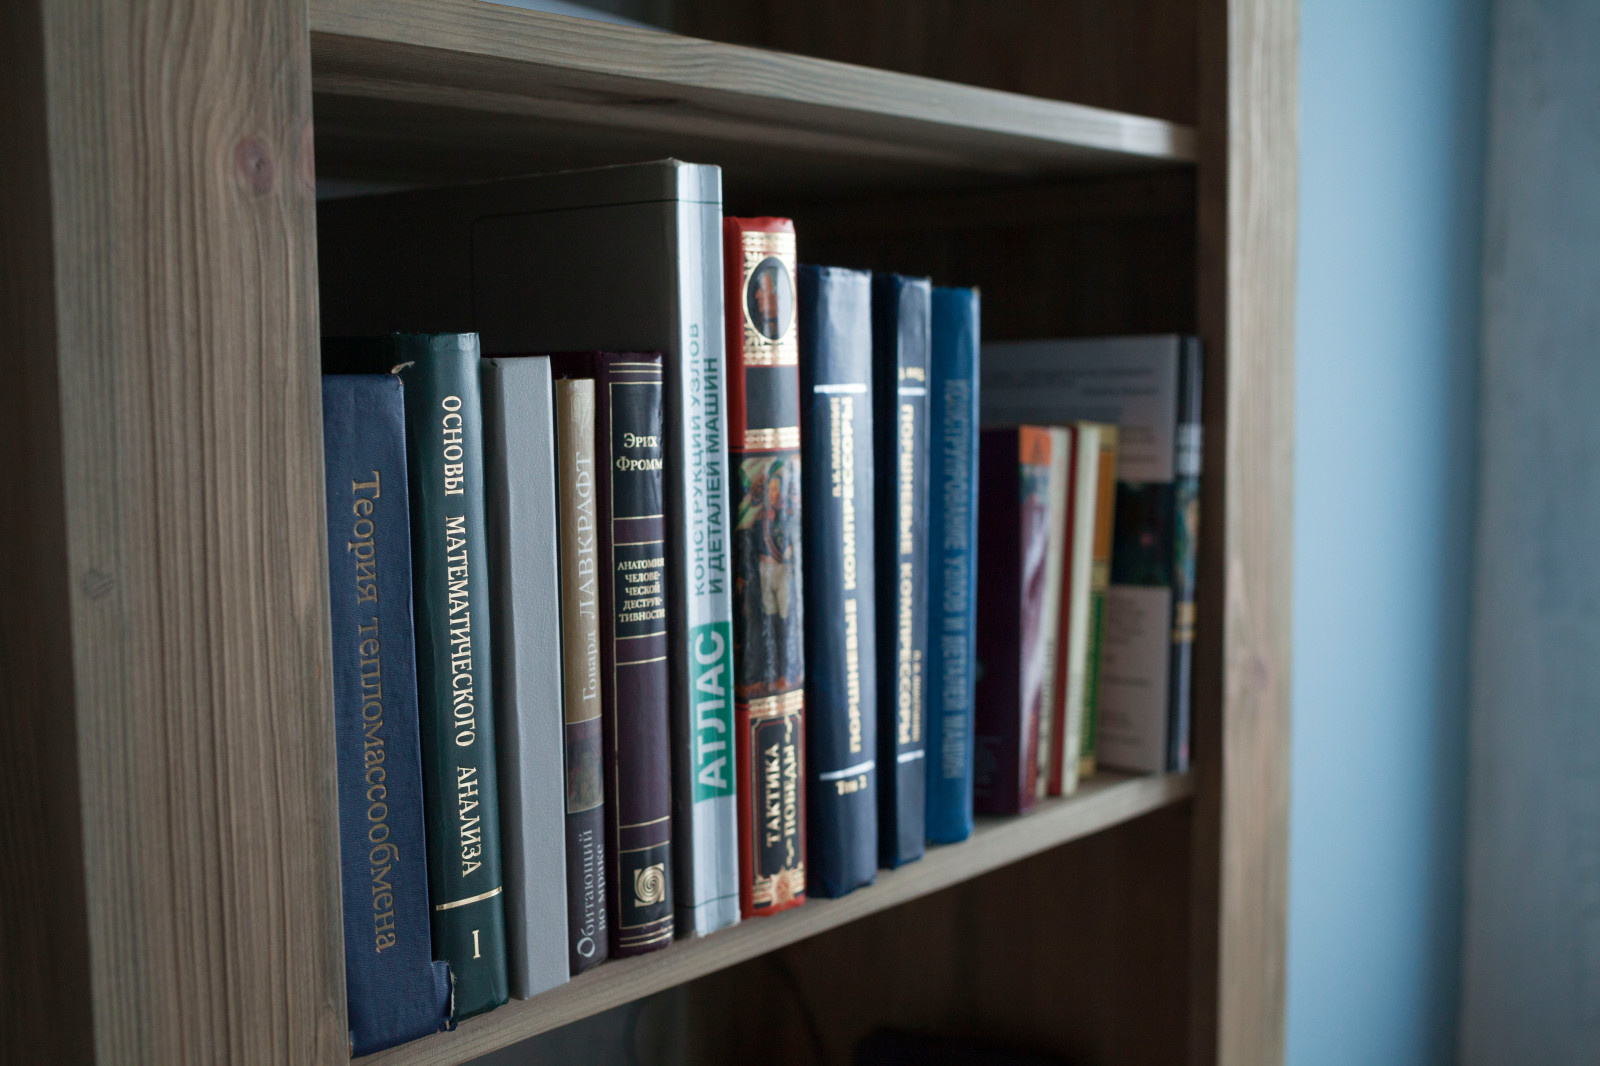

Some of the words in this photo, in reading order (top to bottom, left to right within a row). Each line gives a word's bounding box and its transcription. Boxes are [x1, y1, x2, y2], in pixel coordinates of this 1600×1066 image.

[688, 323, 701, 411] УЗЛОВ
[703, 357, 720, 454] МАШИН
[441, 395, 465, 497] ОСНОВЫ
[690, 415, 705, 597] КОНСТРУКЦИЙ
[841, 396, 856, 590] КОМПРЕССОРЫ
[900, 403, 914, 555] ПОРШНЕВЫЕ
[347, 470, 381, 604] Теория
[575, 451, 596, 620] ЛАВКРАФТ
[703, 460, 725, 573] ДЕТАЛЕЙ
[445, 515, 476, 747] МАТЕМАТИЧЕСКОГО
[624, 581, 661, 596] ЧЕСКОЙ
[708, 578, 723, 594] И
[582, 629, 598, 701] Говард
[694, 630, 728, 789] АТЛАС
[844, 598, 862, 753] ПОРШНЕВЫЕ
[898, 562, 913, 744] КОМПРЕССОРЫ
[359, 616, 399, 953] тепломассообмена
[456, 765, 482, 877] АНАЛИЗА
[764, 742, 782, 848] ТАКТИКА
[783, 744, 797, 836] ПОБЕДЫ
[576, 828, 596, 958] Обитающий
